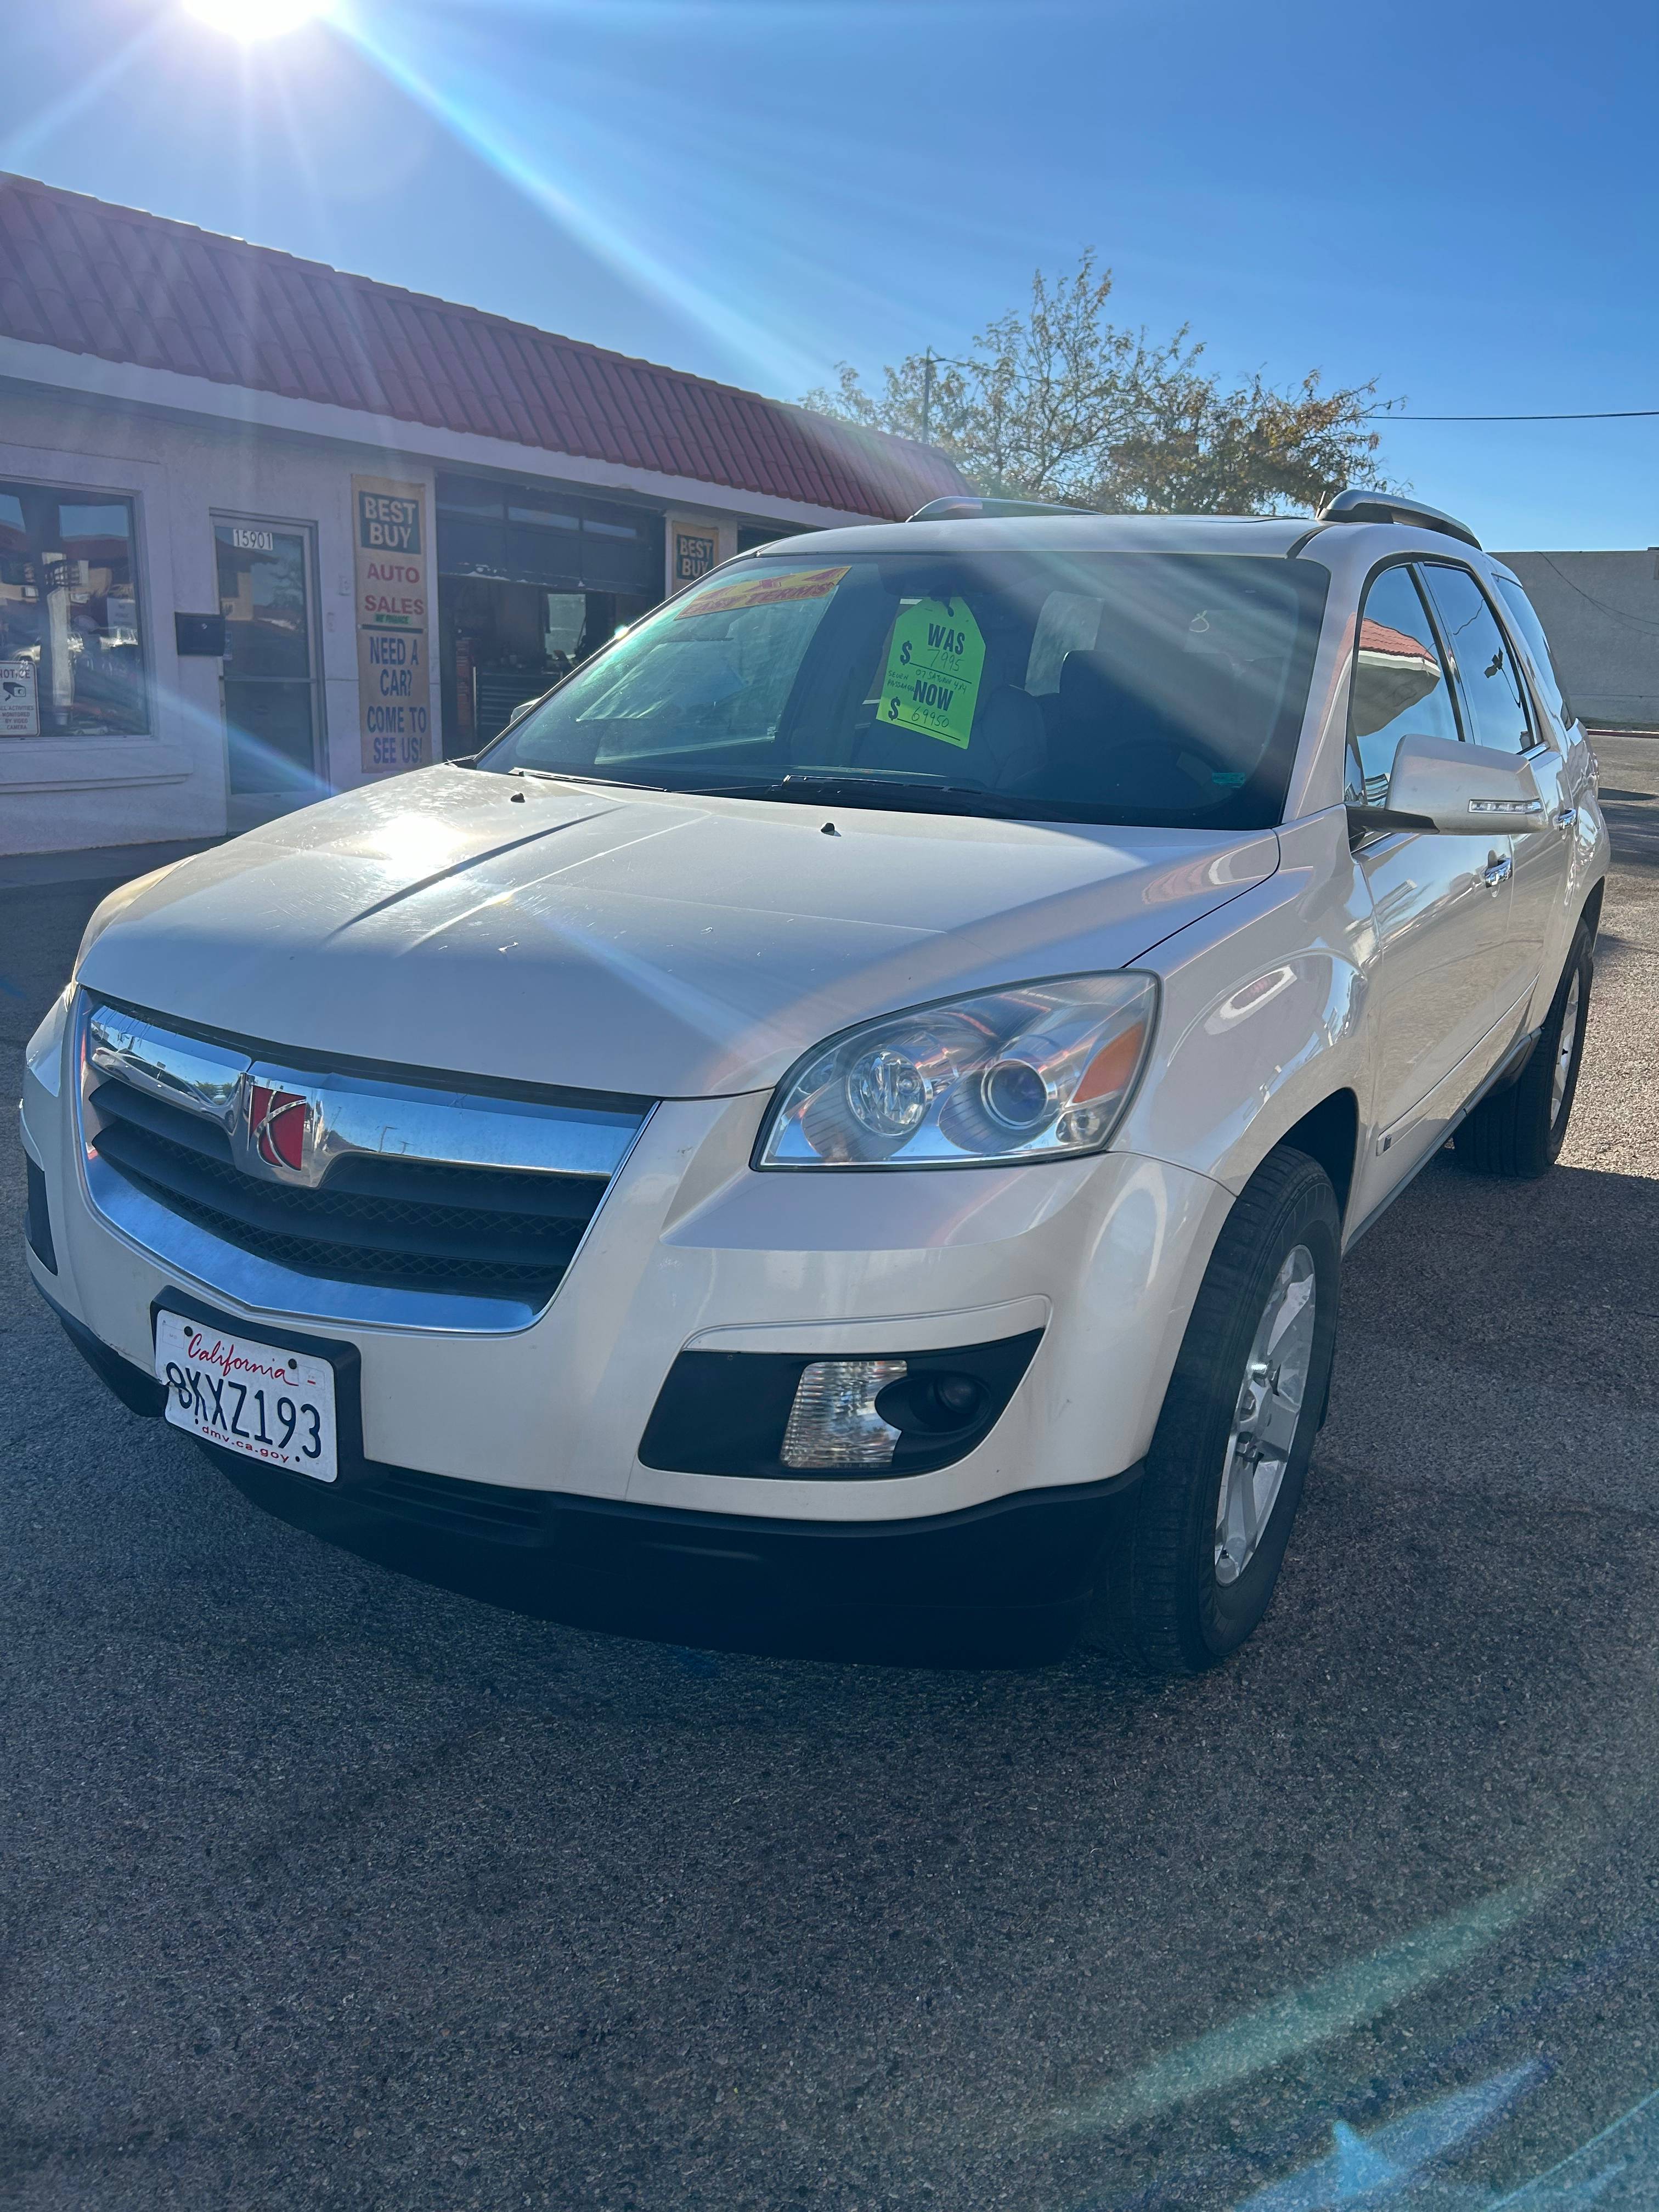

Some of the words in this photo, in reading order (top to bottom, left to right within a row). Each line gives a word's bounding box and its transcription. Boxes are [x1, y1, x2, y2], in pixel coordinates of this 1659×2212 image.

[364, 496, 416, 524] BEST
[235, 529, 272, 549] 15901
[369, 523, 411, 548] BUY
[680, 537, 712, 560] BEST
[367, 563, 420, 584] AUTO
[682, 558, 709, 577] BUY
[364, 594, 425, 615] SALES
[745, 582, 835, 605] TERMS
[369, 636, 406, 665] NEED
[411, 639, 419, 665] A
[928, 623, 966, 654] WAS
[900, 641, 912, 665] $
[927, 649, 965, 672] 7995
[380, 669, 412, 697] CAR?
[888, 670, 909, 680] SEVEN
[928, 670, 952, 685] SATURN
[912, 679, 953, 711] NOW
[367, 706, 405, 733] COME
[409, 707, 427, 733] TO
[888, 697, 901, 721] $
[374, 737, 396, 764] SEE
[402, 737, 422, 763] US!
[188, 1333, 299, 1386] California
[166, 1362, 321, 1459] 8KXZ193
[202, 1426, 290, 1463] dmv.ca.gov
